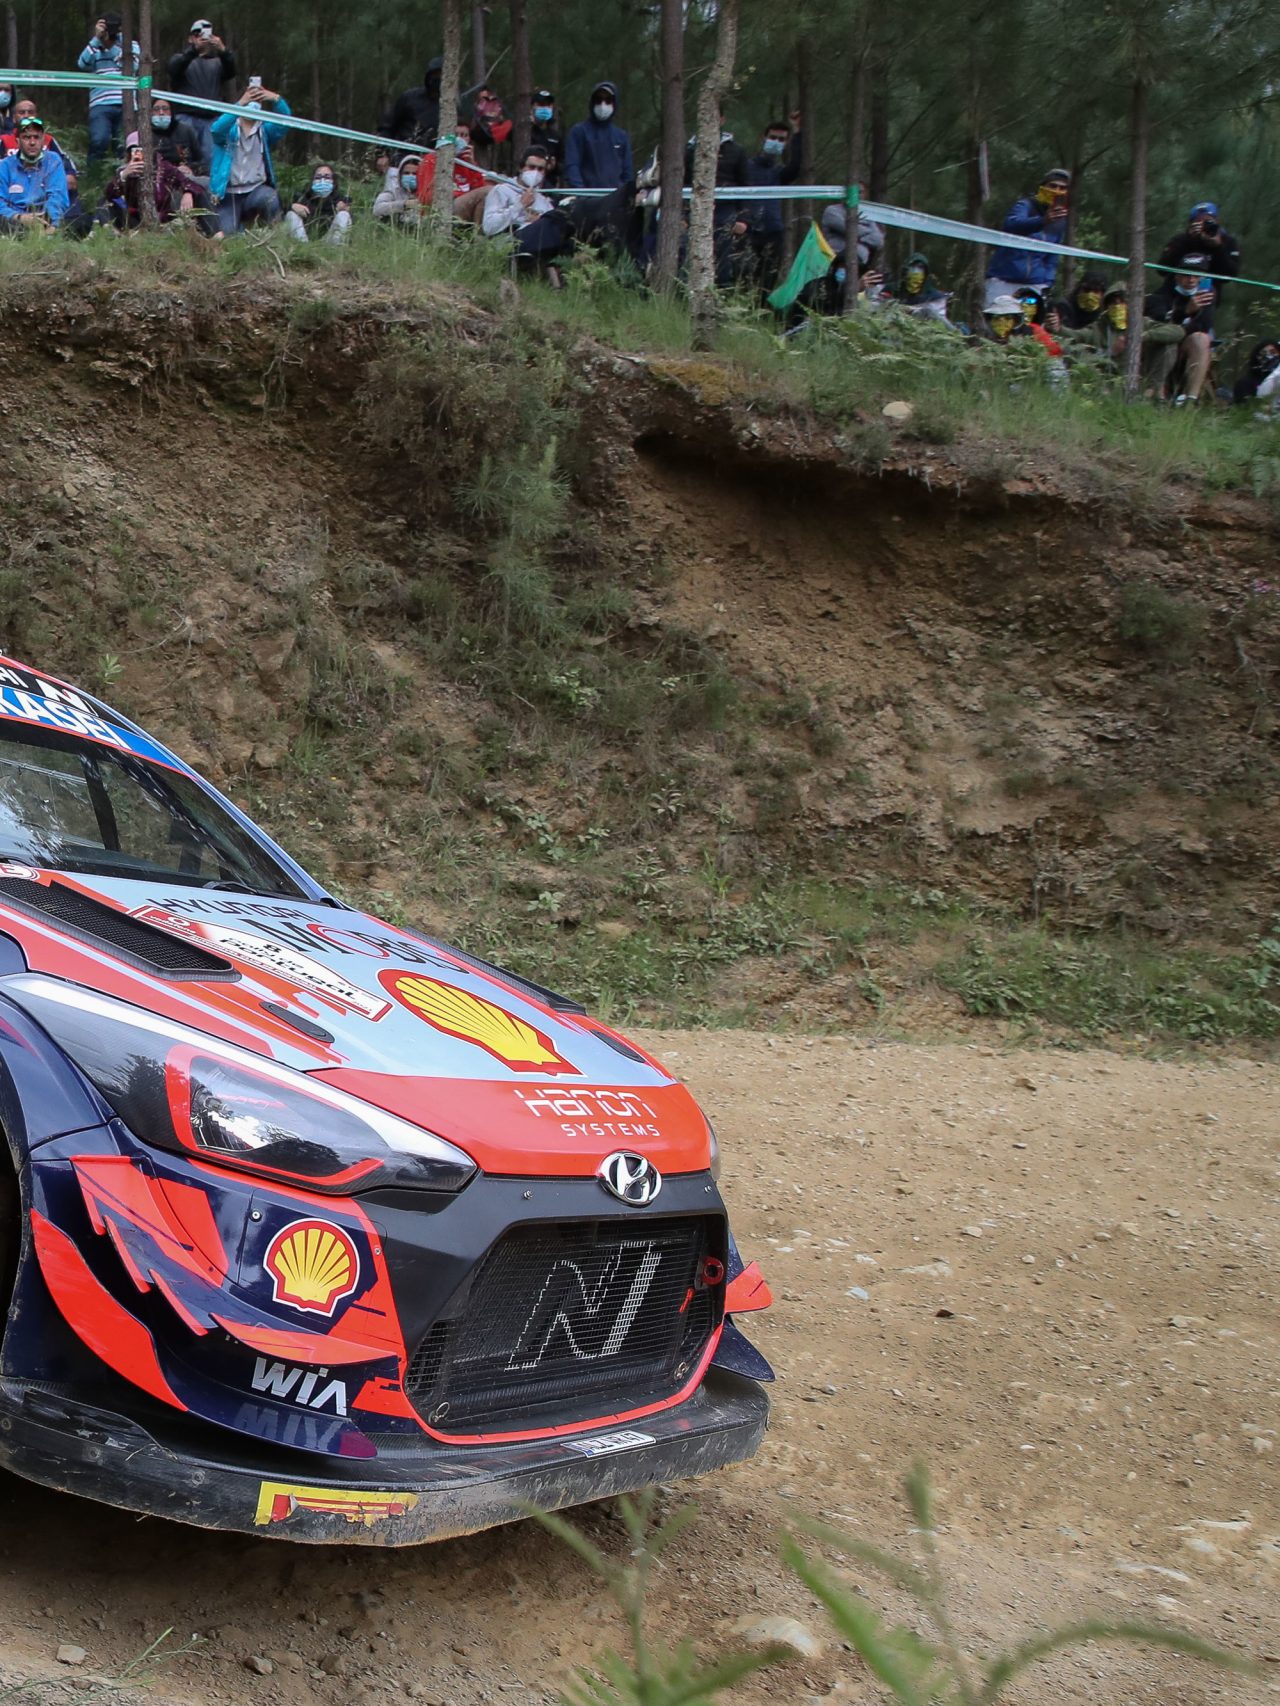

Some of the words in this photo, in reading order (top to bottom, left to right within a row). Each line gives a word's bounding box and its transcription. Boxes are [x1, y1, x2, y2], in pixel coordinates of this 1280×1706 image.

[145, 898, 323, 924] HYUNDAI
[237, 918, 470, 974] MOBIS
[561, 1123, 661, 1137] SYSTEMS
[251, 1356, 347, 1417] WIA
